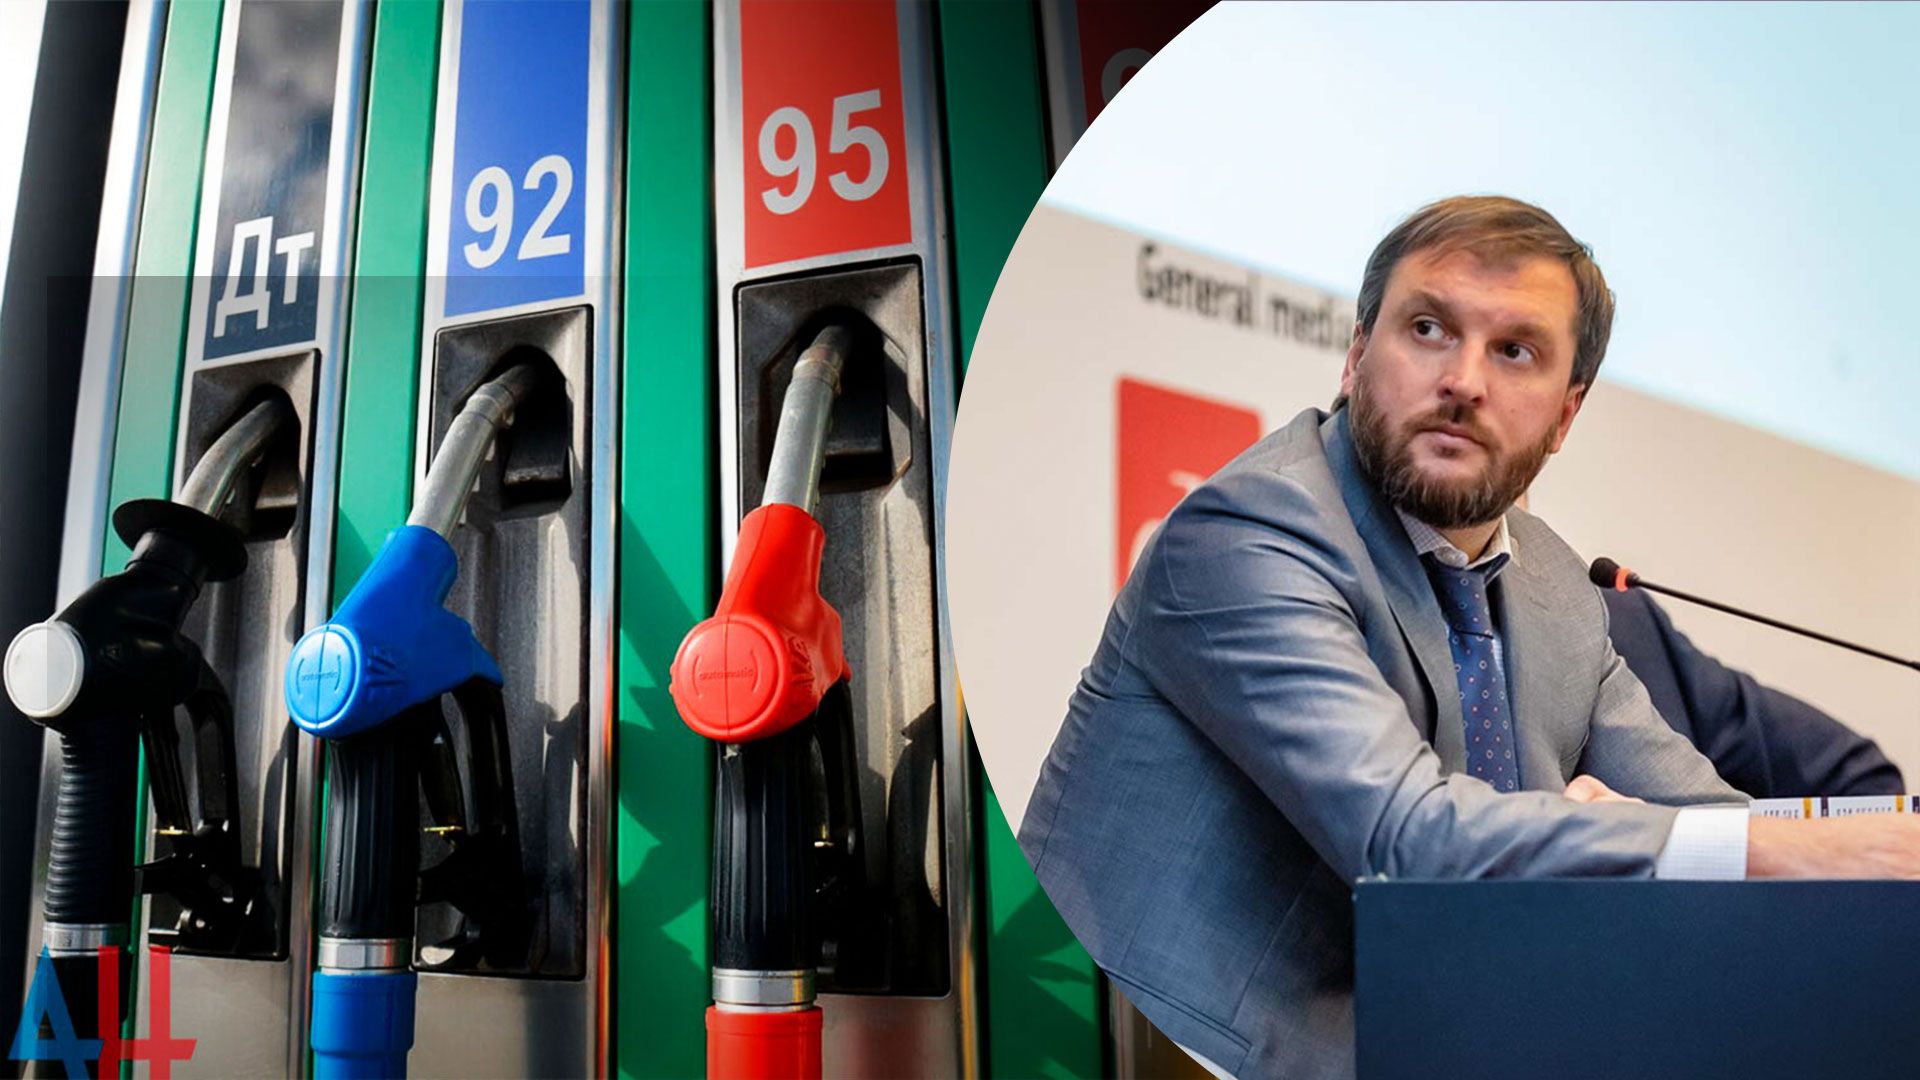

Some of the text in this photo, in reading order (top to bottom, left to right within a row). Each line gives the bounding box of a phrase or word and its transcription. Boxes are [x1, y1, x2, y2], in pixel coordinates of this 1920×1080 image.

[463, 154, 574, 269] 92
[758, 89, 890, 215] 95
[213, 216, 315, 338] Дт
